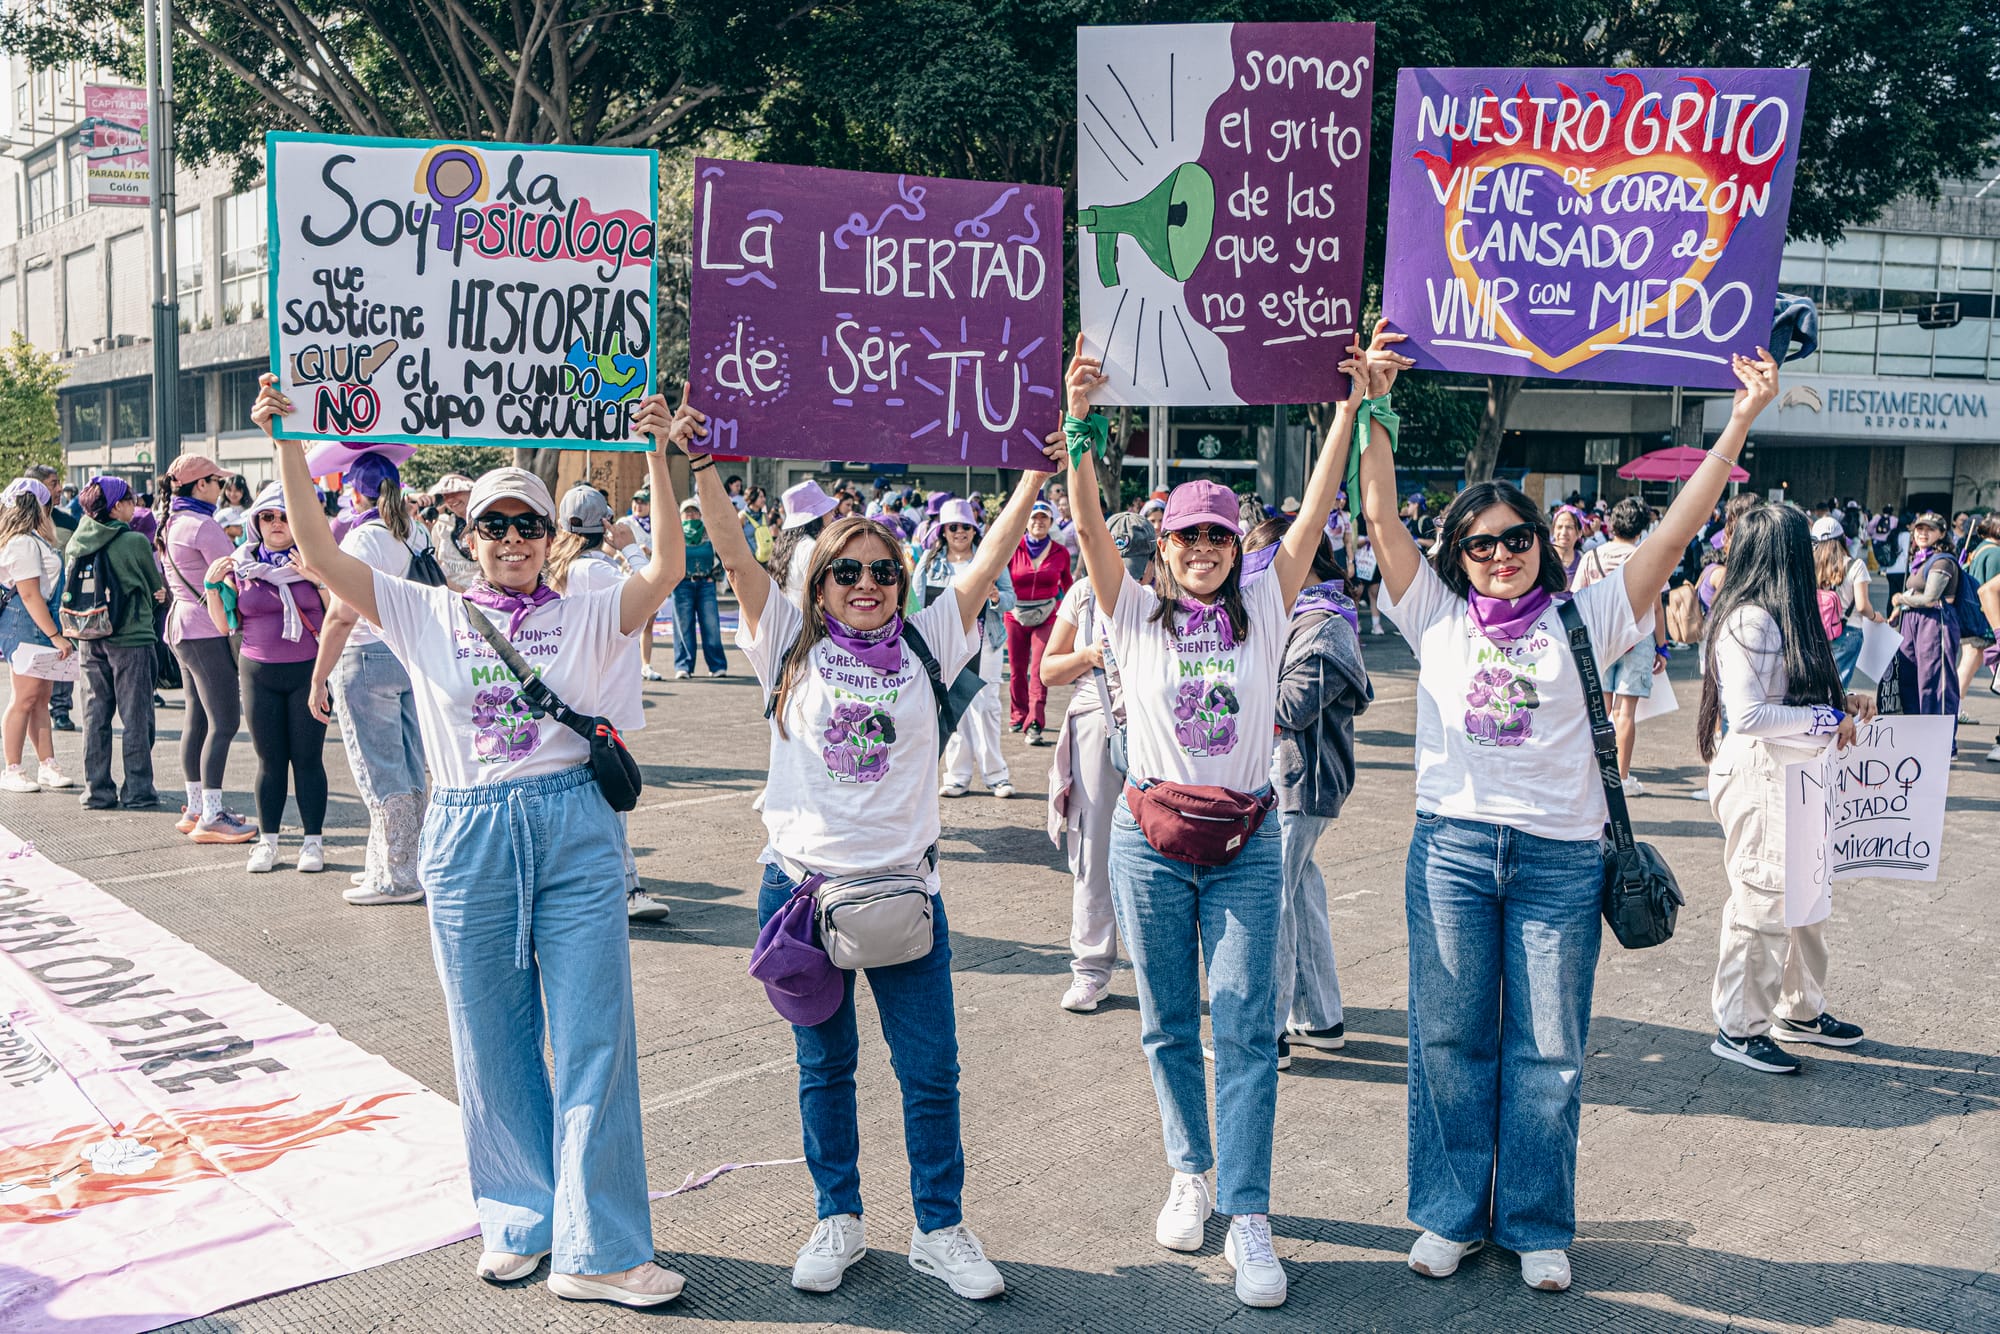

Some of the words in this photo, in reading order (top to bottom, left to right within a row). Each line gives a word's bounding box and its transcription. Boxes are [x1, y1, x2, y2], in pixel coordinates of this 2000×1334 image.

[1219, 107, 1252, 154] el
[1267, 111, 1361, 168] grito
[1416, 94, 1610, 153] NUESTRO
[1623, 92, 1789, 165] GRITO
[89, 169, 125, 179] PARADA
[109, 182, 139, 193] Colón
[1228, 171, 1269, 221] de
[1287, 171, 1335, 224] las
[1428, 166, 1543, 216] VIENE
[1562, 166, 1597, 189] DE
[1601, 174, 1771, 218] CORAZÓN
[301, 154, 431, 275] Soy
[496, 154, 566, 211] la
[700, 180, 774, 270] La
[1557, 194, 1592, 216] UN
[453, 198, 656, 282] psicóloga
[1214, 235, 1279, 278] que
[1289, 236, 1340, 274] ya
[1449, 219, 1655, 270] CANSADO
[1672, 229, 1723, 263] de
[313, 266, 364, 306] que
[819, 230, 1046, 301] LIBERTAD
[282, 292, 424, 339] sostiene
[447, 278, 650, 357] HISTORIAS
[1202, 292, 1246, 323] no
[1258, 284, 1353, 338] están
[1425, 276, 1522, 341] VIVIR
[1528, 281, 1571, 306] CON
[1588, 277, 1754, 343] MIEDO
[397, 347, 438, 395] el
[463, 359, 601, 398] MUNDO
[715, 321, 782, 397] de
[828, 321, 911, 394] Ser
[927, 349, 1020, 437] TÚ
[317, 385, 377, 432] NO
[1828, 388, 1988, 418] FIESTAMERICANA
[1865, 416, 1948, 430] REFORMA
[456, 647, 470, 660] SE
[1177, 640, 1216, 653] SIENTE
[1179, 656, 1235, 677] MAGIA
[1516, 638, 1549, 656] CMO
[471, 664, 542, 687] MAGA
[819, 666, 834, 680] SE
[836, 671, 878, 689] SIENTE
[1585, 654, 1602, 695] hunter
[1591, 697, 1608, 727] rctic
[0, 878, 98, 954] OMEN
[26, 955, 175, 1008] ON
[90, 1007, 290, 1095] FIRE
